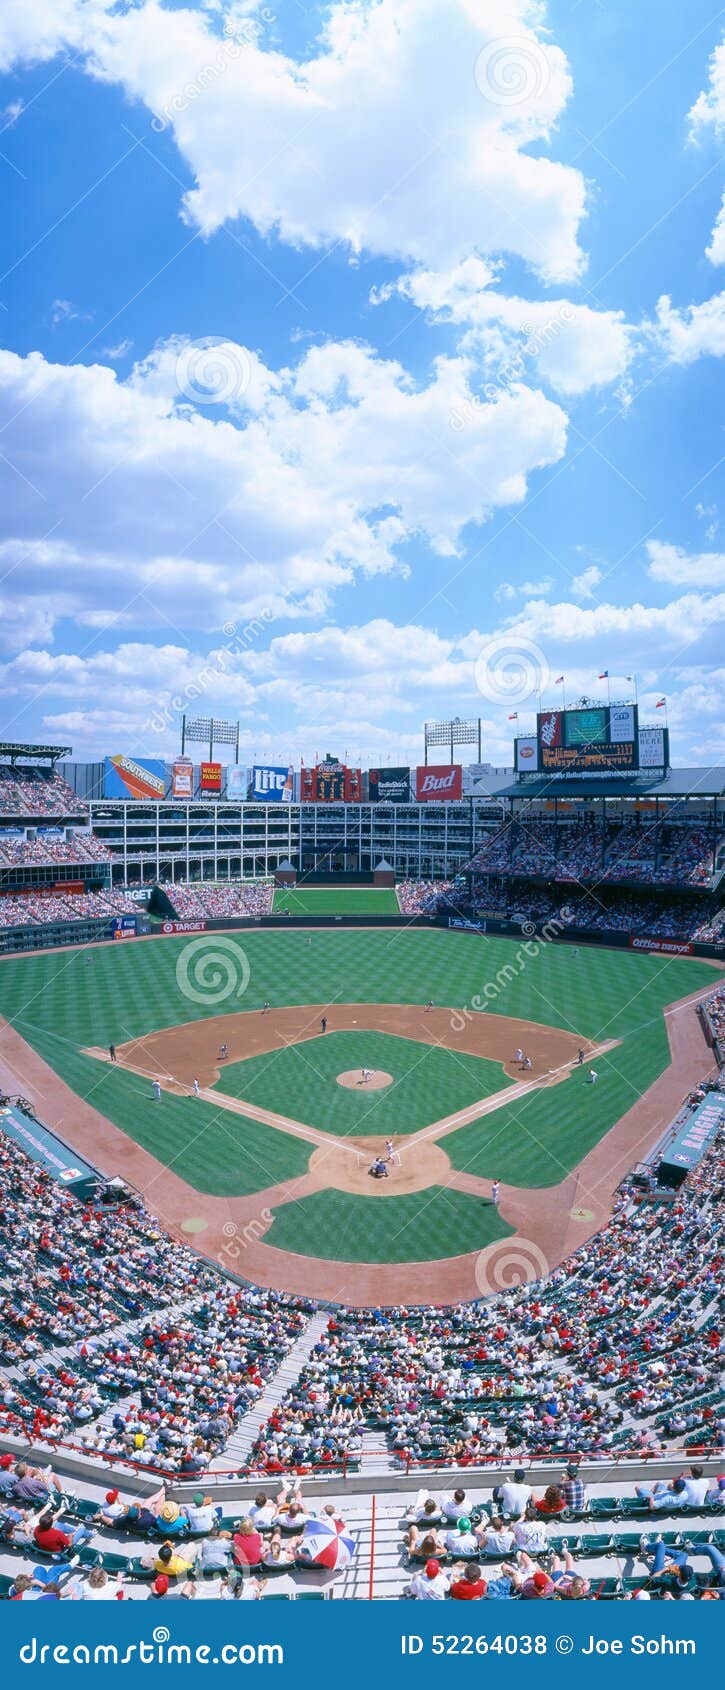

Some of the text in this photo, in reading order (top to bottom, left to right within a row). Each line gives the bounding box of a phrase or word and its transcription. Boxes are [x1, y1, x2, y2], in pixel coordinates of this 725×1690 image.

[120, 758, 161, 791] SOUTHWEST
[254, 769, 286, 794] Lite
[421, 770, 457, 792] Bud
[174, 922, 206, 931] TARGET
[632, 938, 660, 949] Office
